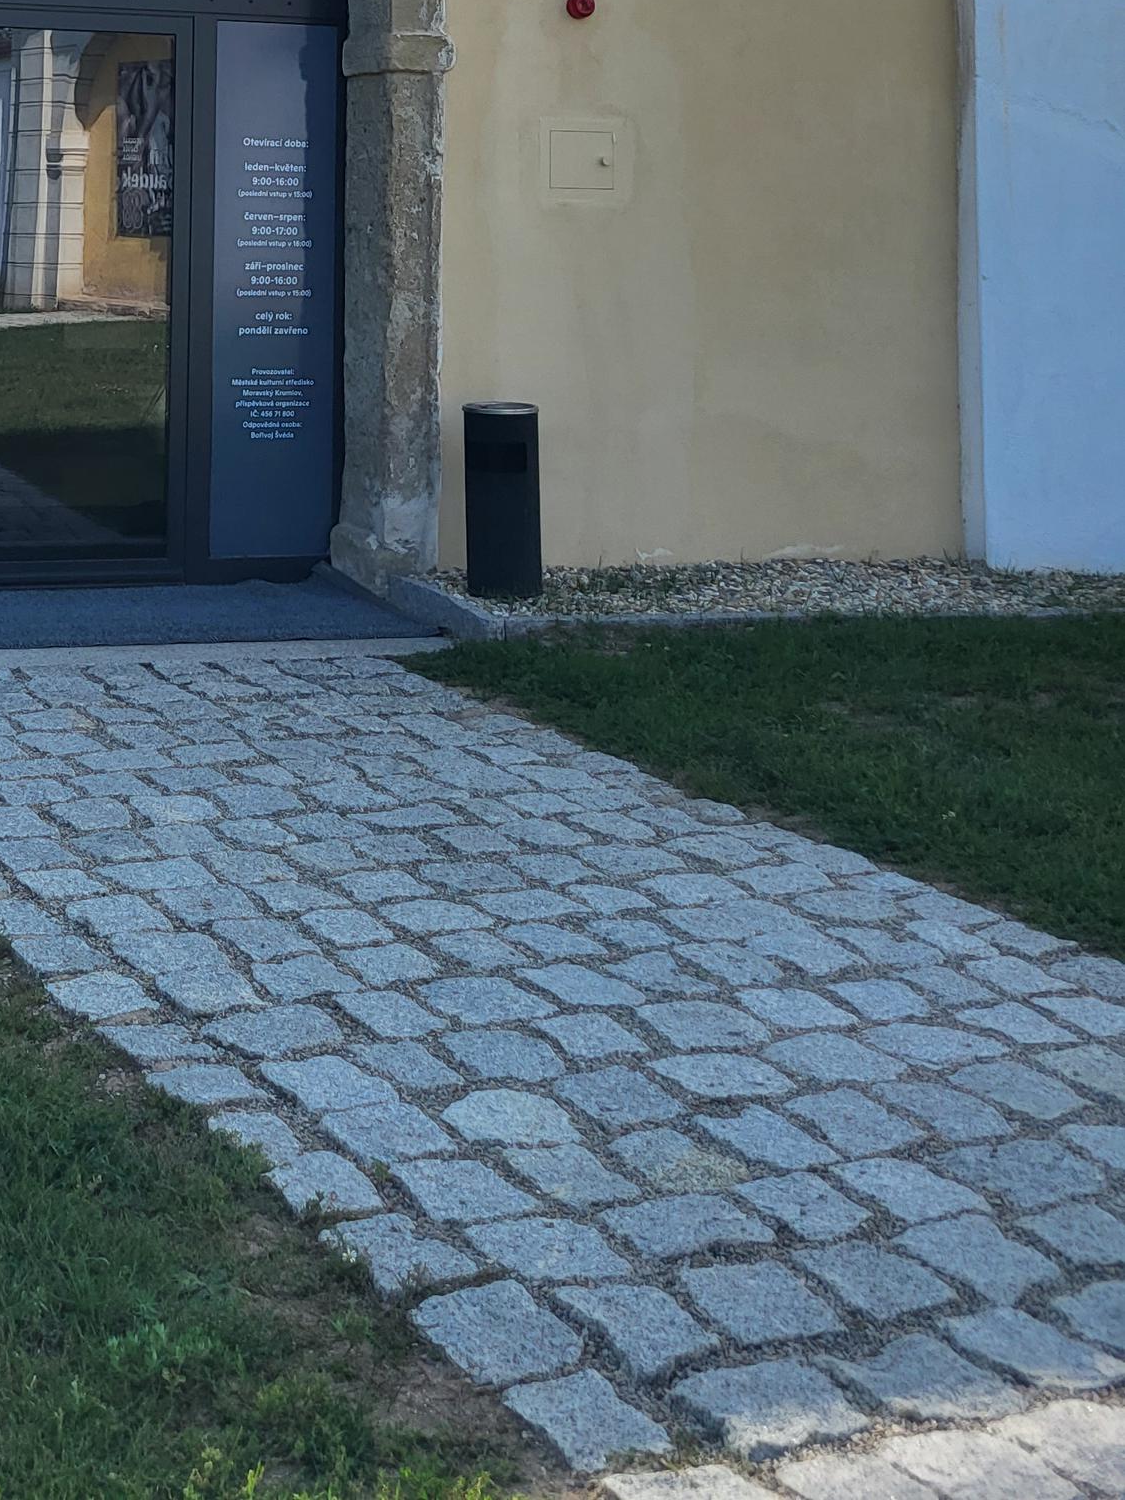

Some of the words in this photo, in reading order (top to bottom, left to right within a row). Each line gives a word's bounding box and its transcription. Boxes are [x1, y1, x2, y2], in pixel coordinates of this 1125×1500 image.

[243, 137, 283, 148] Otevírací
[284, 138, 309, 148] doba:
[252, 176, 299, 186] 9:00-16:00
[237, 188, 268, 198] (poslední
[269, 190, 287, 199] vstup
[251, 226, 298, 236] 9:00-17:00
[237, 238, 268, 247] (poslední
[268, 239, 287, 248] vstup
[250, 276, 298, 285] 9:00-16:00
[236, 288, 267, 297] (poslední
[268, 289, 286, 298] vstup
[255, 311, 274, 322] celý
[275, 312, 293, 321] rok:
[238, 326, 272, 336] pondělí
[274, 327, 308, 335] zavřeno
[242, 389, 274, 398] Moravský
[275, 400, 310, 408] organizace
